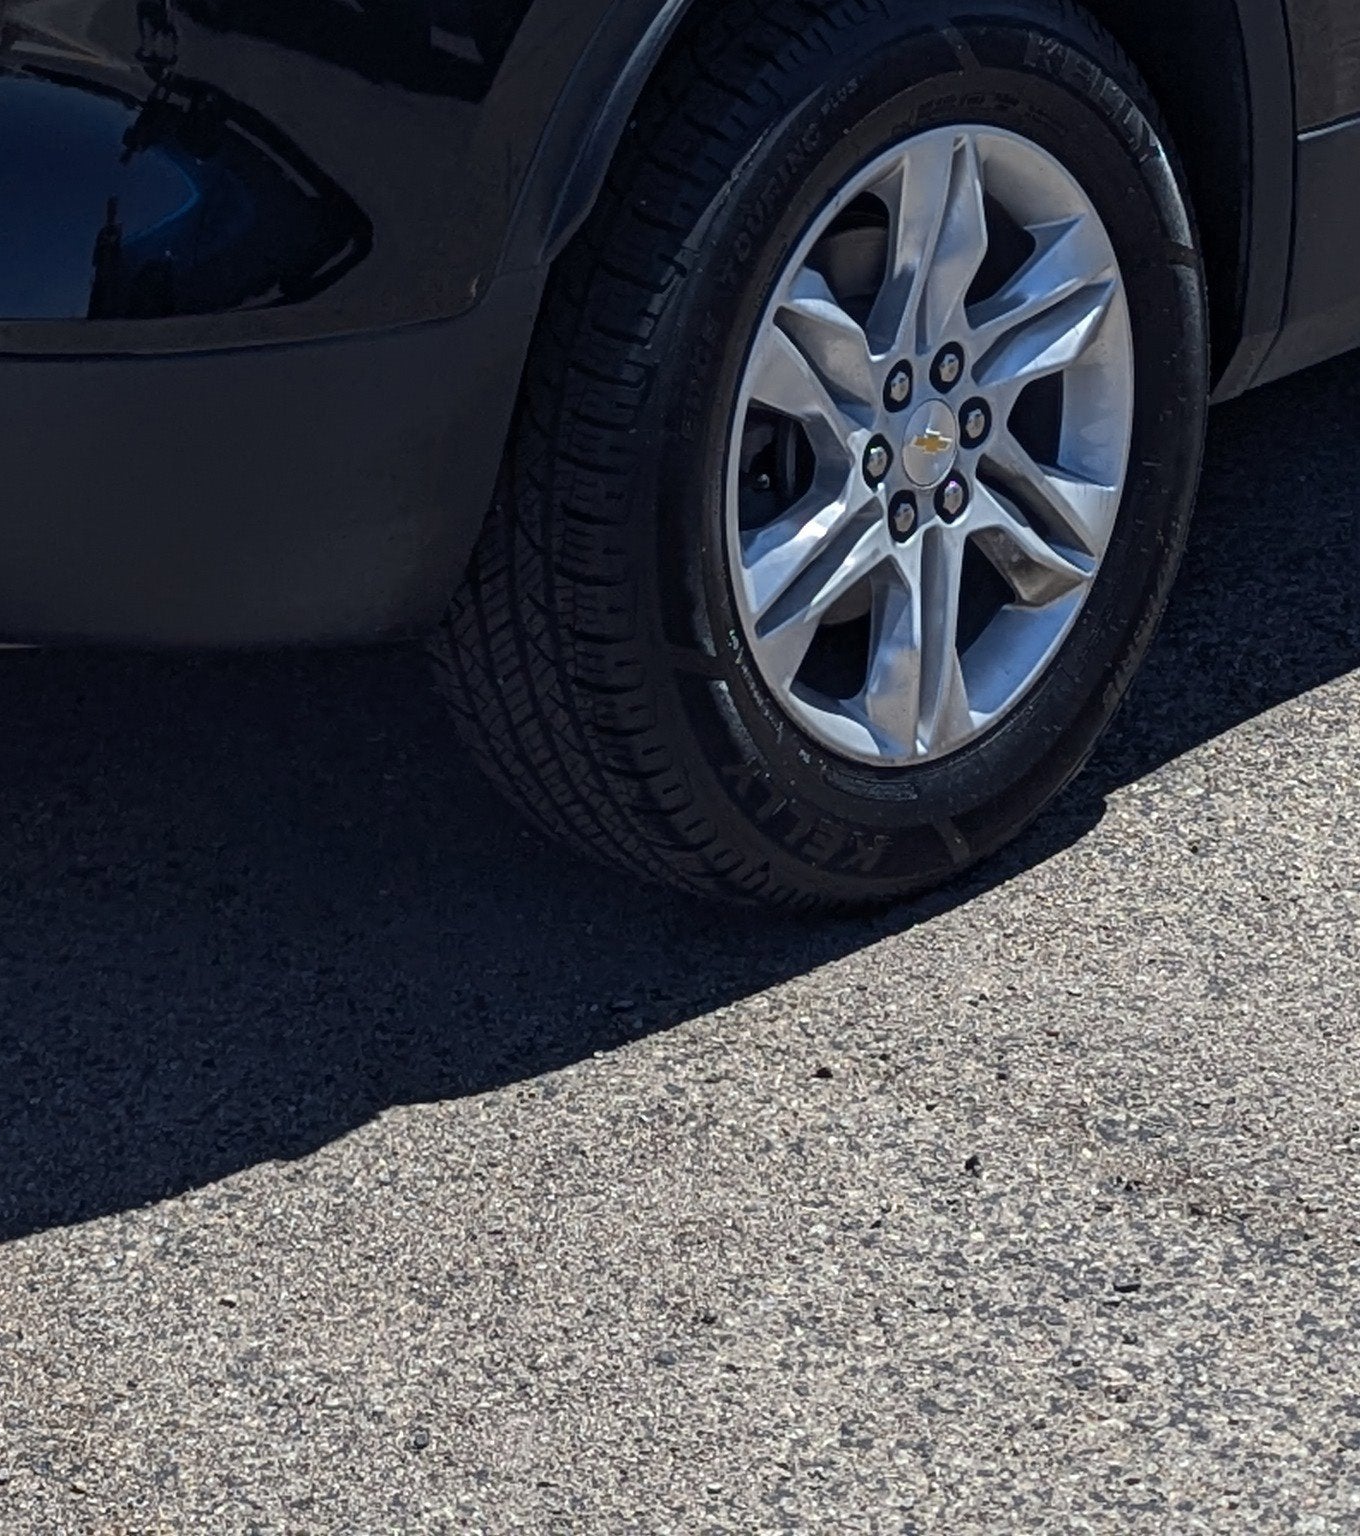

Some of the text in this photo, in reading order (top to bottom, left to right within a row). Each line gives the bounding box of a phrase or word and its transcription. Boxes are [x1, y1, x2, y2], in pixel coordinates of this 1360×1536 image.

[715, 122, 821, 285] TOURING
[821, 78, 858, 115] PLUS
[1023, 31, 1160, 163] KELLY
